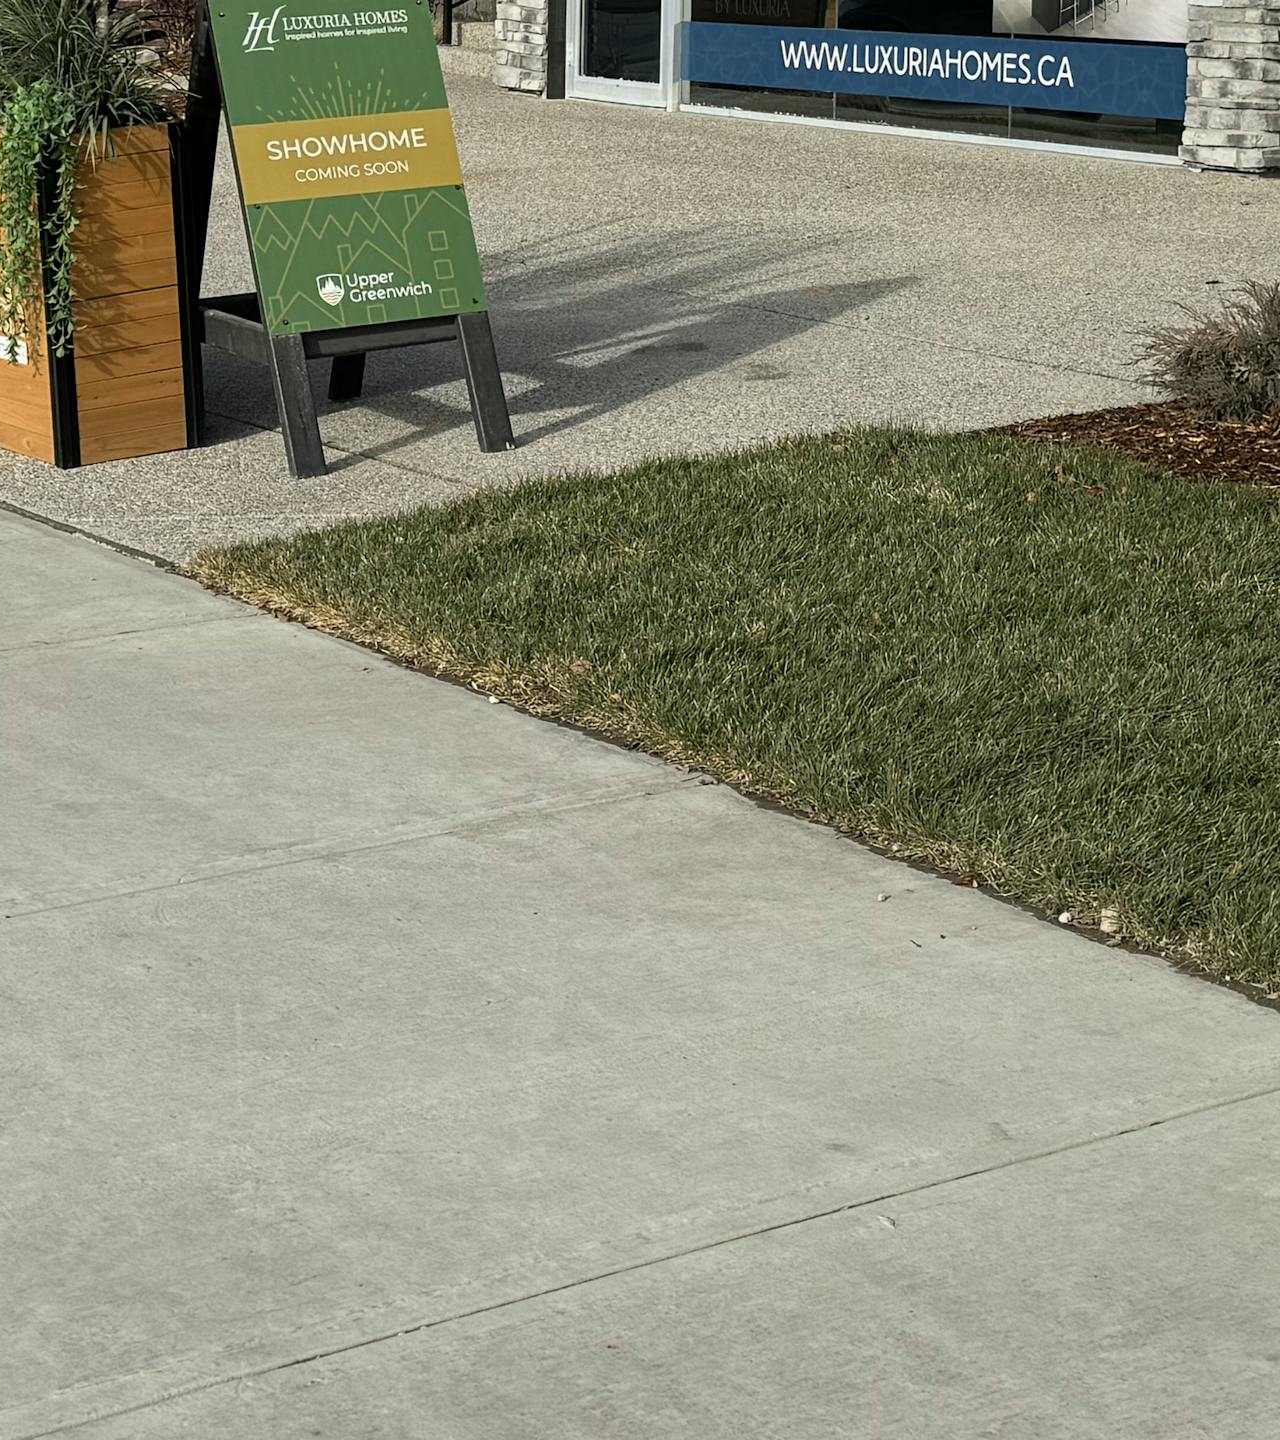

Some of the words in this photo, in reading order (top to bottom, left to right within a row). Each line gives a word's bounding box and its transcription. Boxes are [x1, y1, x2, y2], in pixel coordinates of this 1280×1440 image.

[283, 13, 352, 31] LUXURIA
[354, 9, 409, 26] HOMES
[317, 29, 344, 39] homes
[344, 27, 355, 36] for
[387, 24, 408, 34] living
[780, 39, 1075, 88] WWW.LUXURIAHOMES.CA
[266, 127, 428, 161] SHOWHOME
[294, 164, 361, 182] COMING
[364, 160, 409, 176] SOON
[345, 272, 394, 289] Upper
[349, 281, 432, 303] Greenwich
